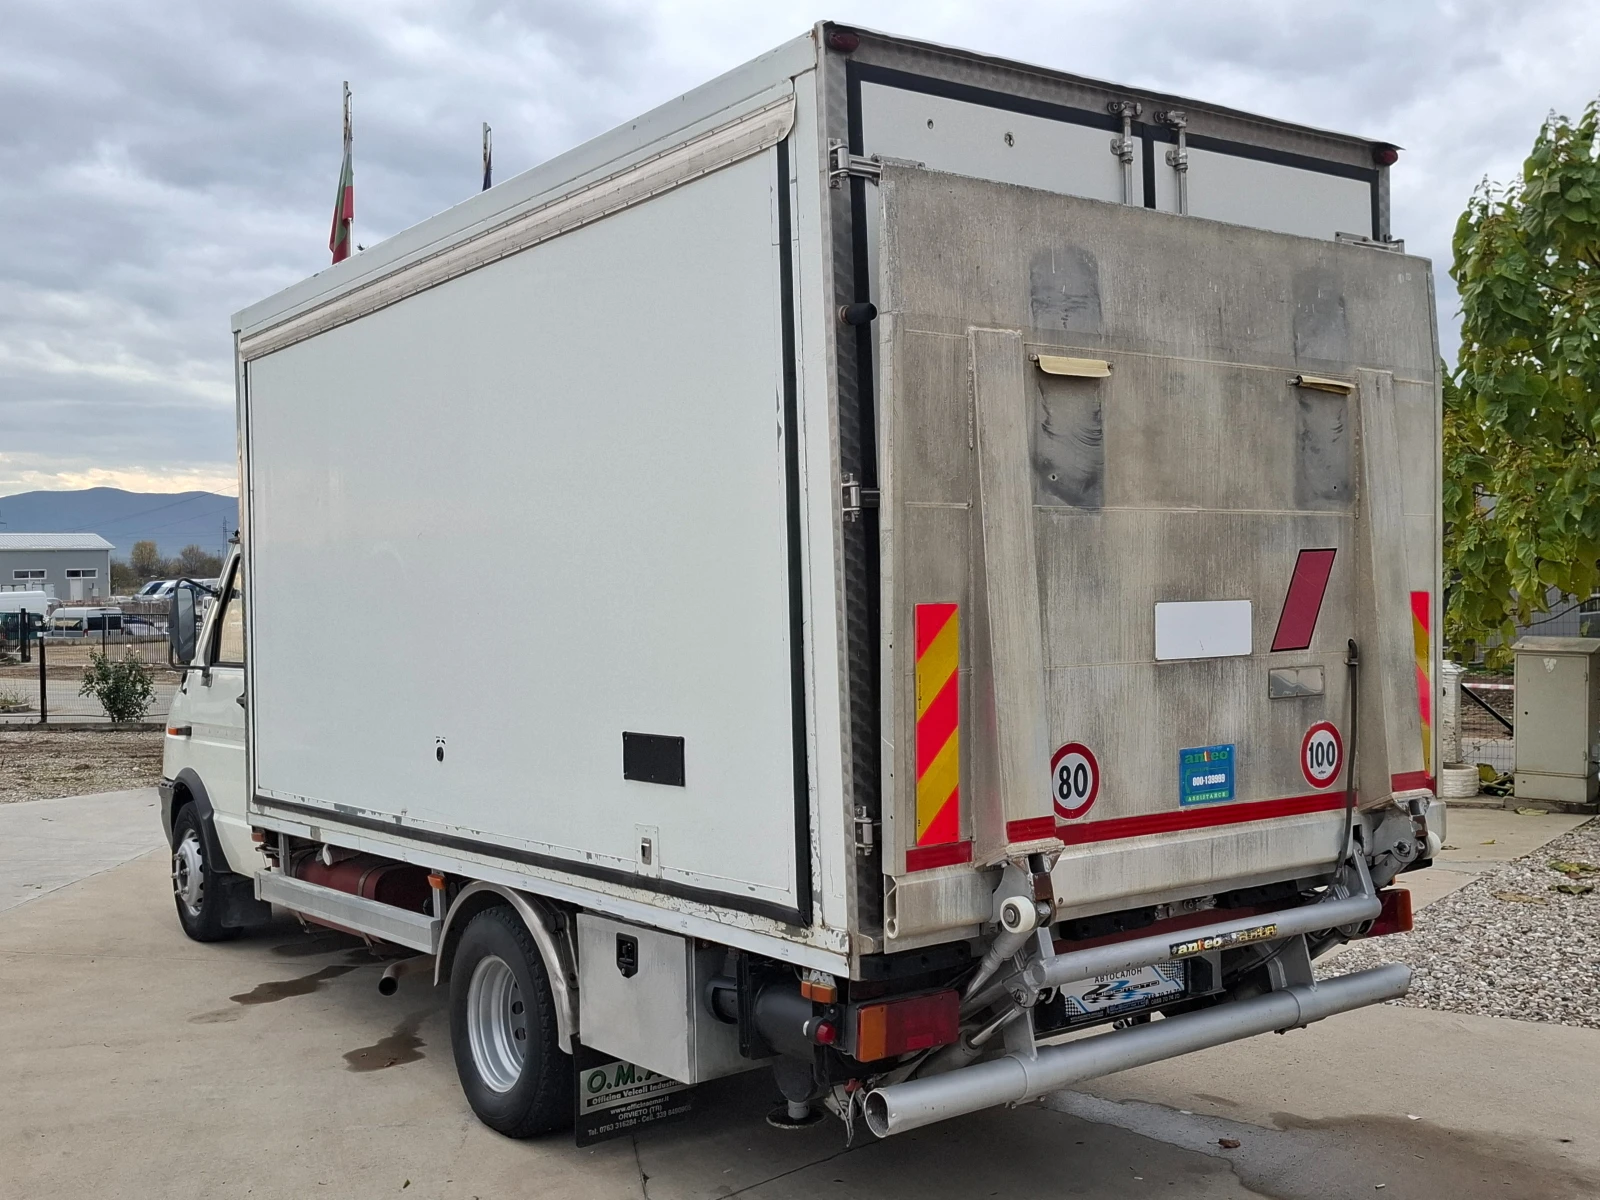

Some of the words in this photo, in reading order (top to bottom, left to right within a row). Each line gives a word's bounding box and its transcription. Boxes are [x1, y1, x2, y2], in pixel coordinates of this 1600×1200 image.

[1185, 751, 1228, 764] anteo
[1309, 740, 1336, 769] 100
[1059, 763, 1088, 800] 80
[1178, 937, 1222, 955] anteo
[1094, 968, 1142, 984] АВТОСАЛОН
[592, 1093, 621, 1105] Officina
[623, 1085, 648, 1098] Veicoli
[618, 1108, 648, 1120] ORVIETO
[588, 1128, 599, 1136] Tel.
